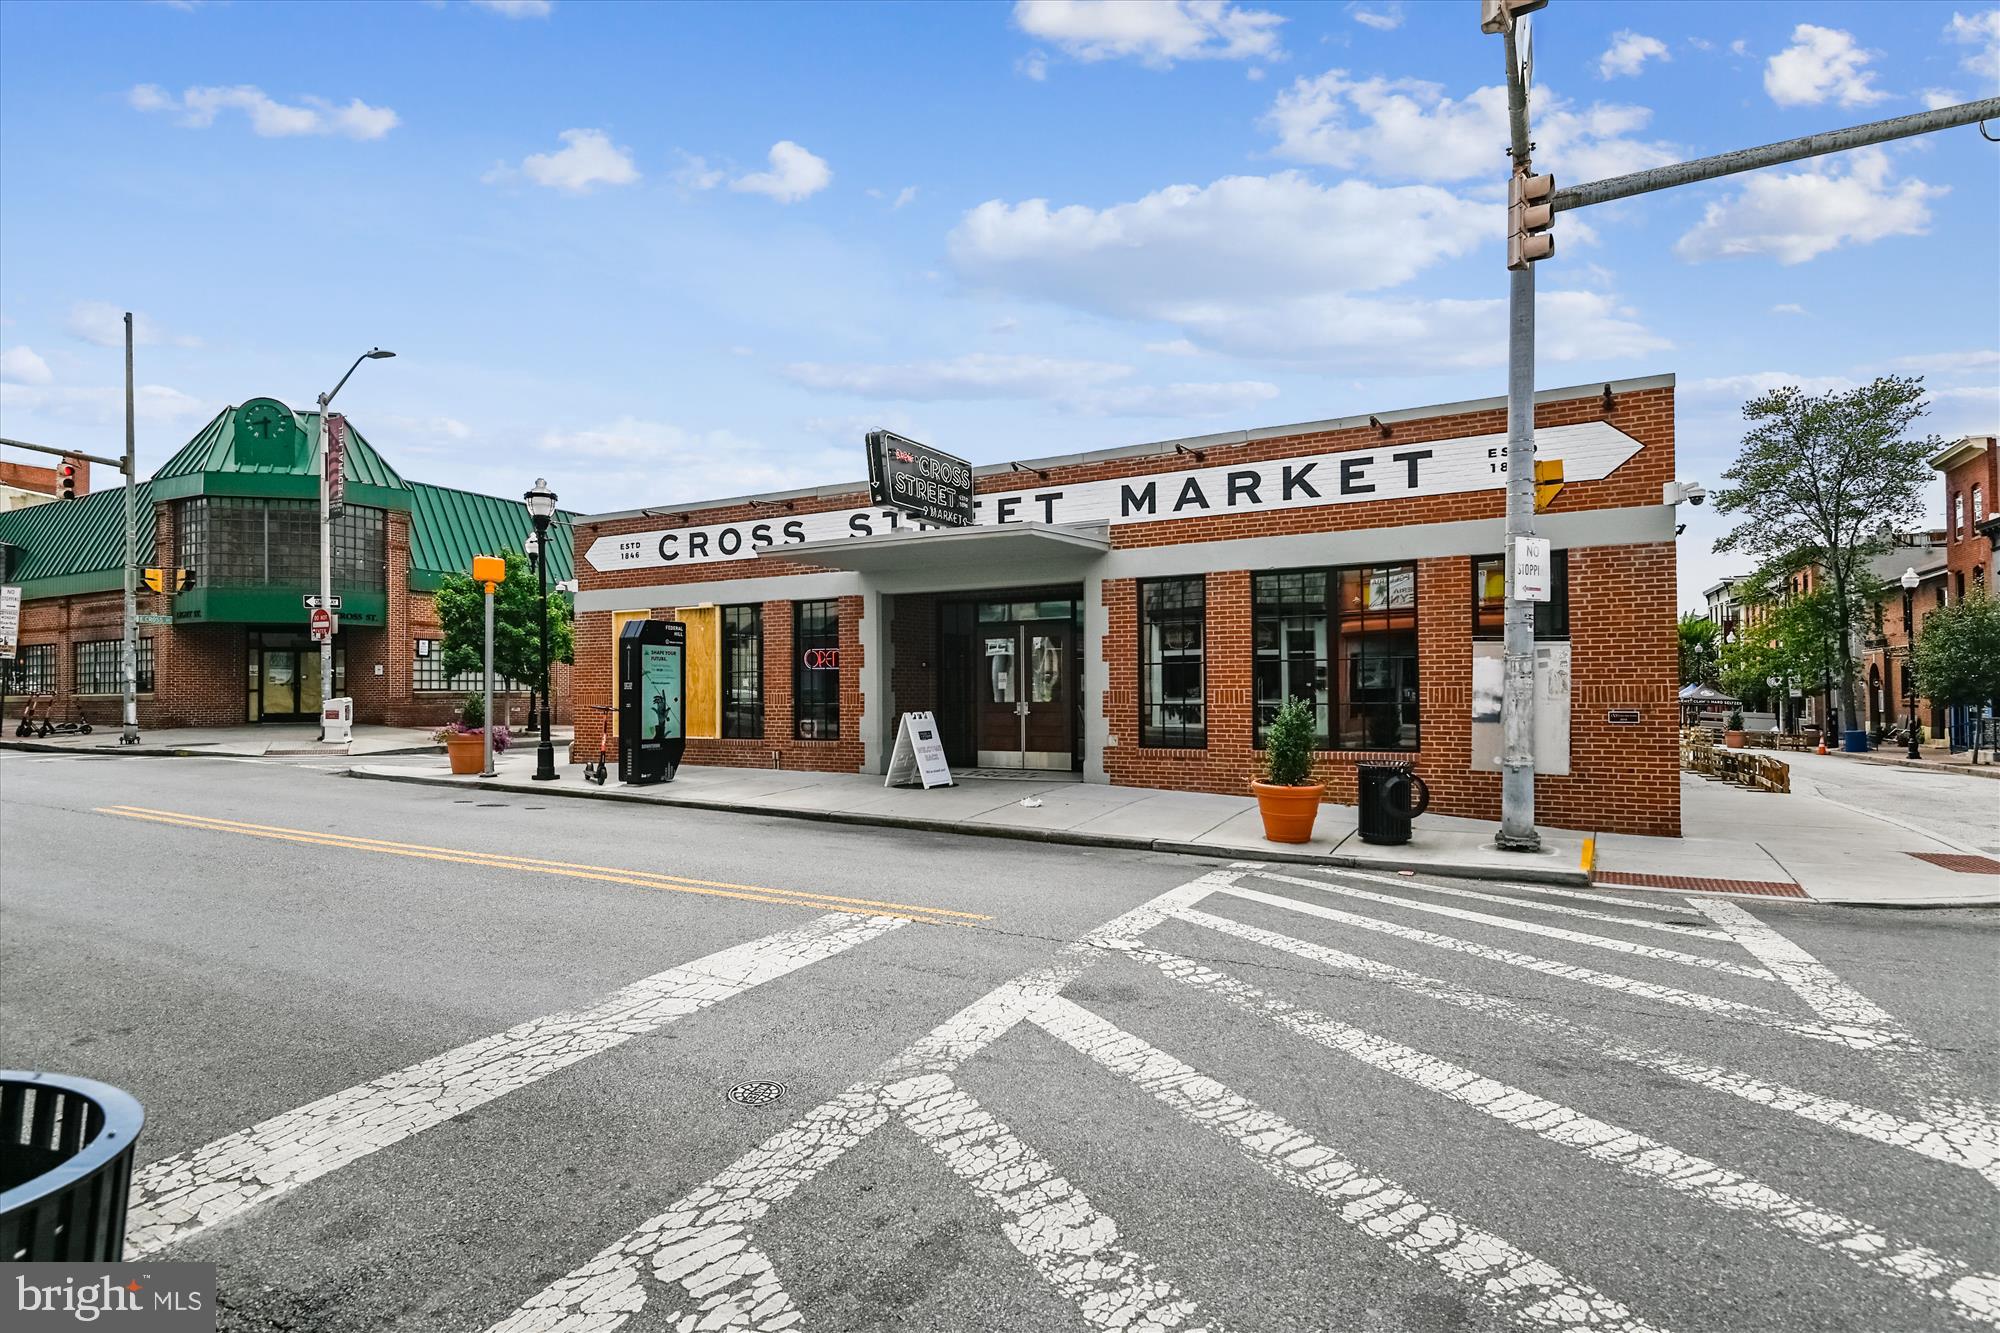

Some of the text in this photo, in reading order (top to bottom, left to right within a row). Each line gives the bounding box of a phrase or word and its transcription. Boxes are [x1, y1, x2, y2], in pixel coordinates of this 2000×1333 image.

[918, 456, 970, 489] CROSS
[1490, 462, 1508, 473] 18
[894, 471, 956, 507] STREET
[658, 449, 1433, 561] CROSS STET MARKET
[929, 505, 962, 525] MARKET
[620, 541, 641, 550] ESTD
[1526, 545, 1540, 557] NO
[621, 552, 640, 560] 1846
[1517, 563, 1540, 576] STOPPI
